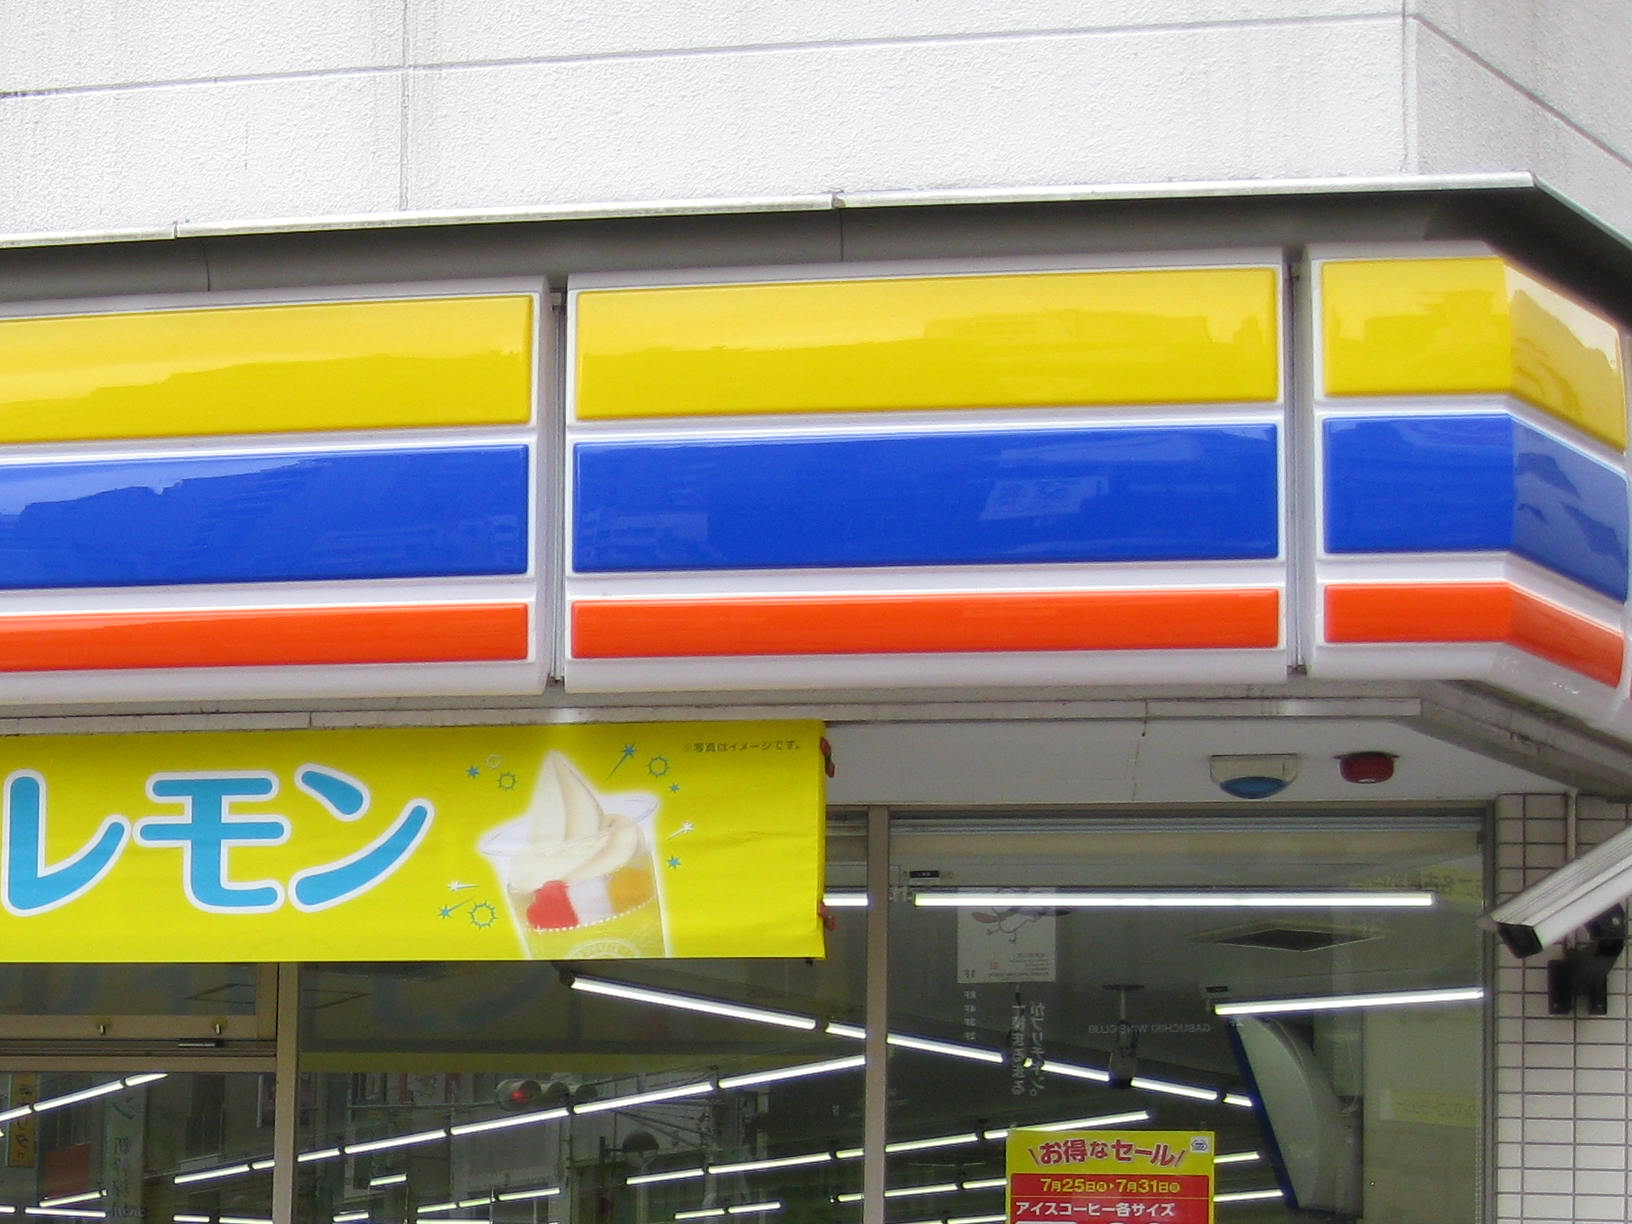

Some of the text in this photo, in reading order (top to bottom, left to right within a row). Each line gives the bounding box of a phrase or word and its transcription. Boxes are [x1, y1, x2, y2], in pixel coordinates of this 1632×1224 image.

[1039, 1139, 1176, 1167] お得なセール
[1015, 1202, 1175, 1217] アイスコーヒー各サイズ
